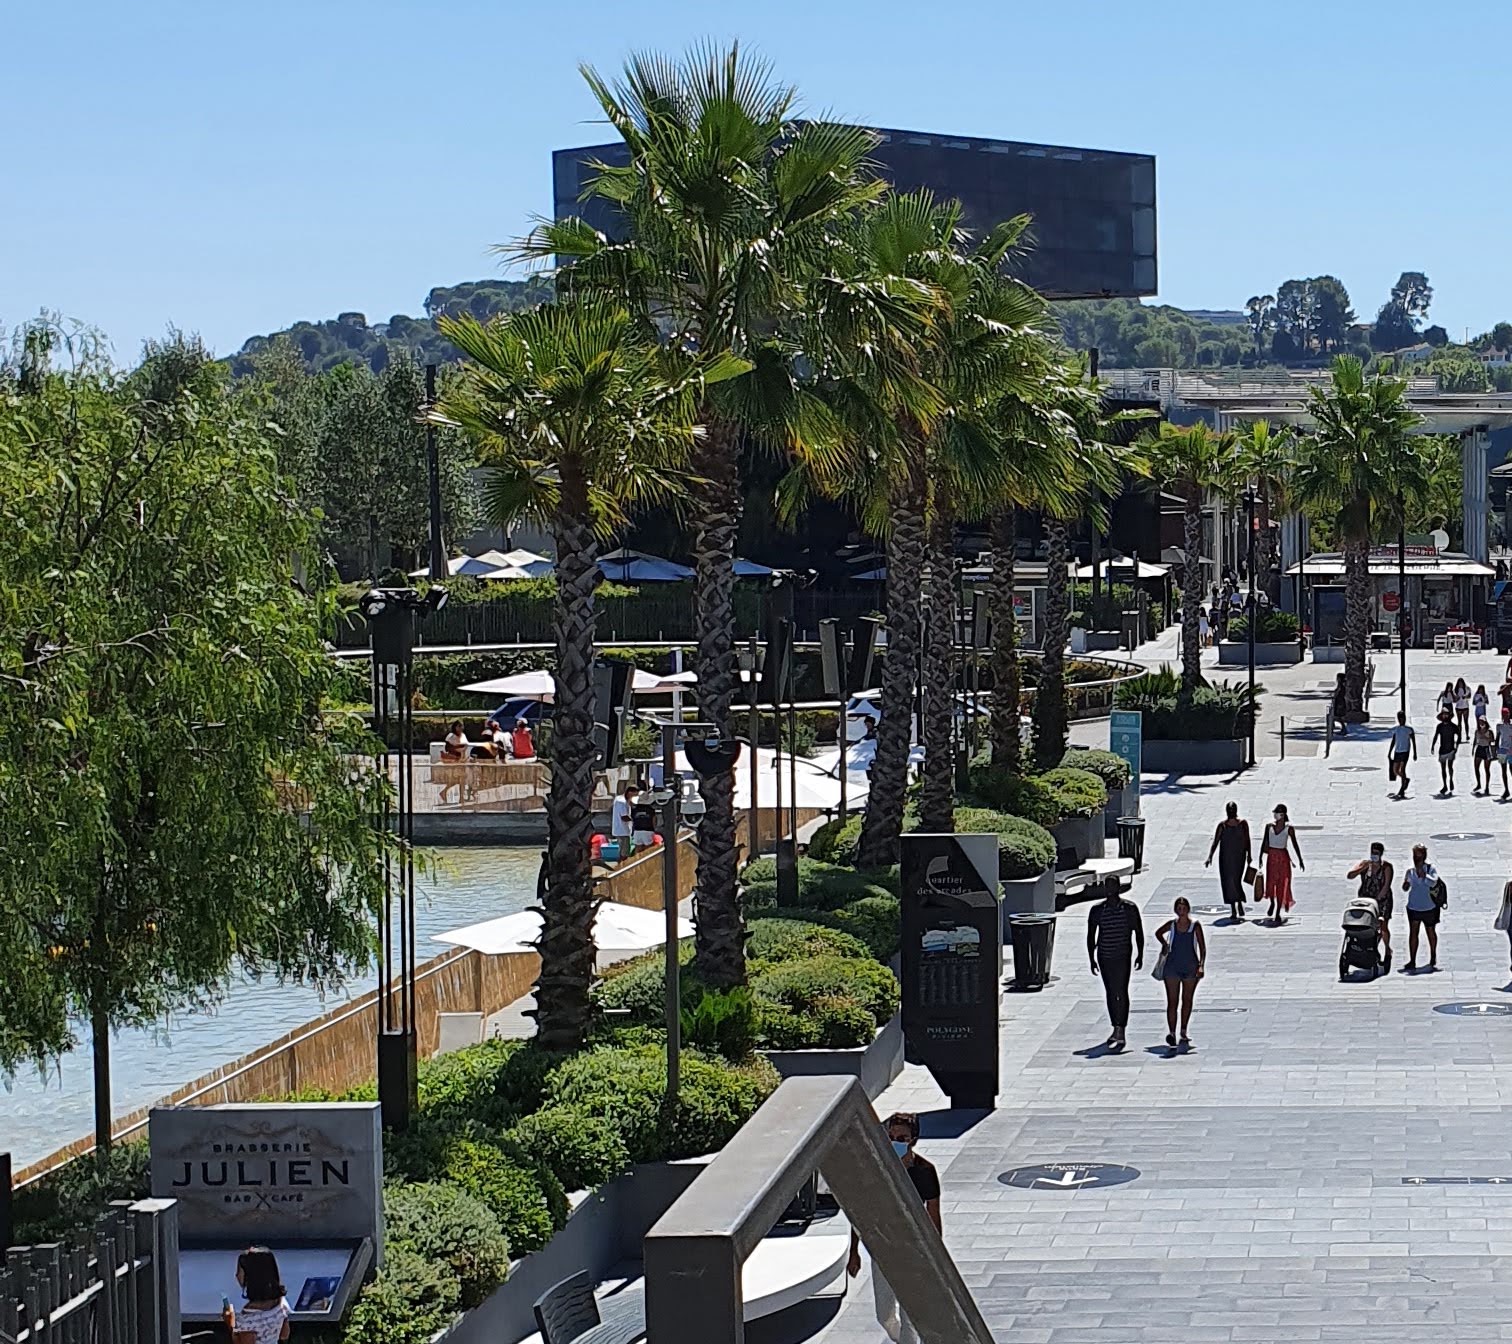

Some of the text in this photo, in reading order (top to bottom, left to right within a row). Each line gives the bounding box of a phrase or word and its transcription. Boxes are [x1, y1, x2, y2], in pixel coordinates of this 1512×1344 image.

[212, 1143, 311, 1153] BRASSERIE
[172, 1160, 349, 1187] JULIEN
[224, 1195, 251, 1203] BAR
